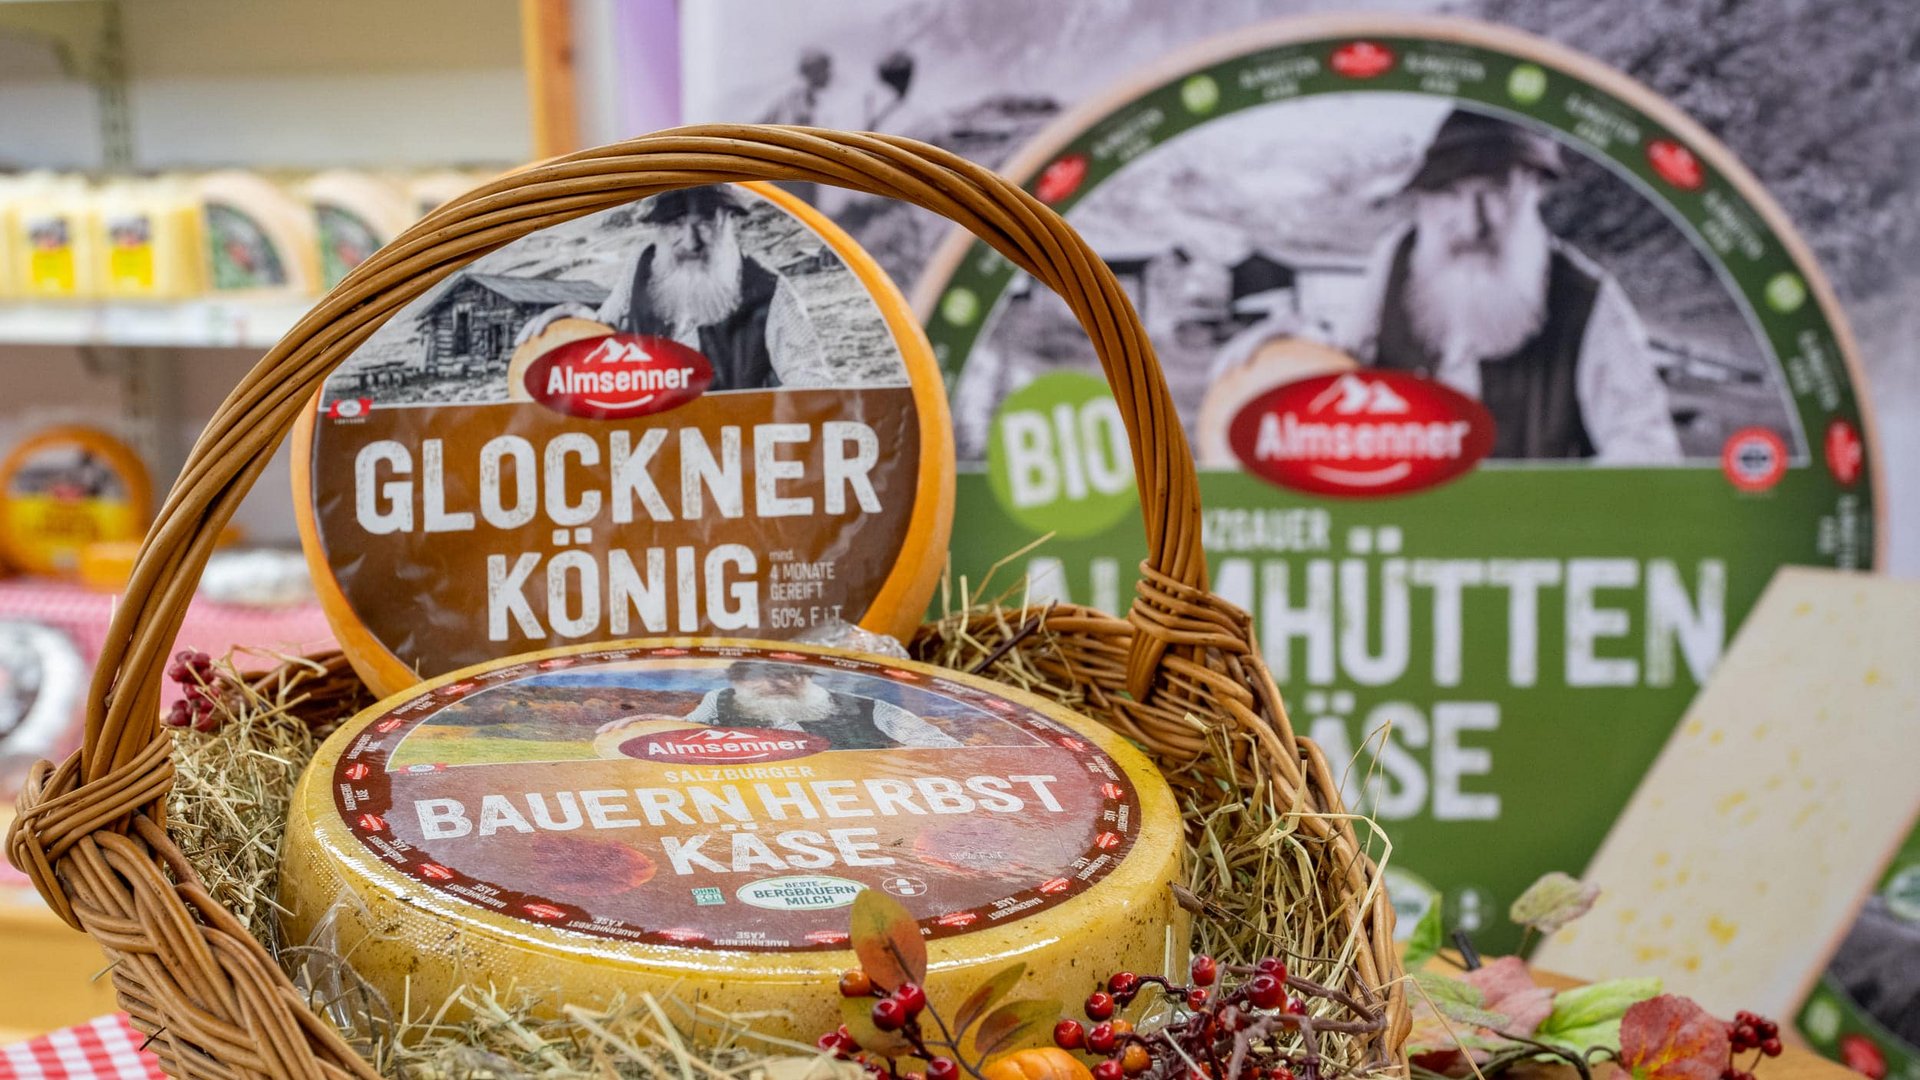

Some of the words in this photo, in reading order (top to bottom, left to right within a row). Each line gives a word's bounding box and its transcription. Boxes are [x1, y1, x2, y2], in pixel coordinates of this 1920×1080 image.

[546, 365, 694, 395] Almsenner
[1254, 412, 1472, 461] Almsenner
[1003, 396, 1132, 509] BIO
[355, 421, 883, 535] GLOCKNER
[770, 564, 778, 580] 4
[783, 561, 835, 580] MONATE
[487, 527, 760, 641] KÖNIG
[770, 582, 823, 600] GEREIFT
[771, 607, 805, 628] 50%
[647, 739, 808, 757] Almsenner
[1304, 691, 1501, 820] ÄSE
[663, 766, 816, 783] SALZBURGER
[660, 822, 896, 876] KÄSE
[753, 886, 857, 899] BERGBAUERN
[785, 880, 820, 889] BESTE
[785, 895, 836, 907] MILCH
